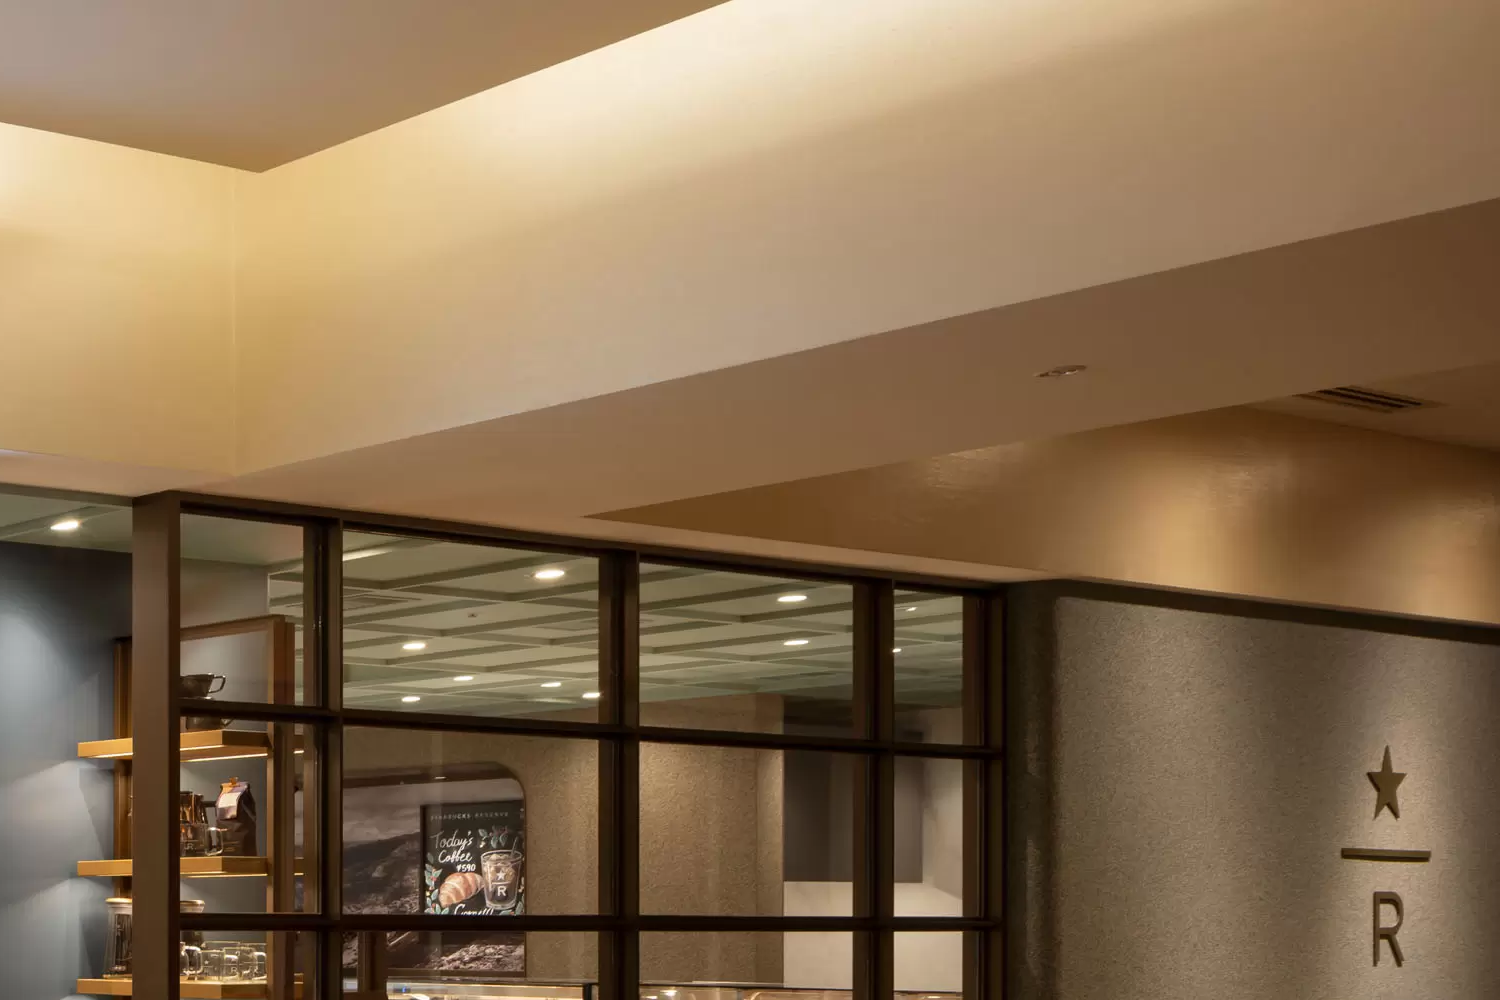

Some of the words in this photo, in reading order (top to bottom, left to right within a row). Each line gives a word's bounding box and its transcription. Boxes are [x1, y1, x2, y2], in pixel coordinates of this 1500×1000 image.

[430, 829, 474, 850] Today's
[438, 848, 473, 864] Coffee
[497, 885, 507, 897] R
[1373, 891, 1405, 967] R
